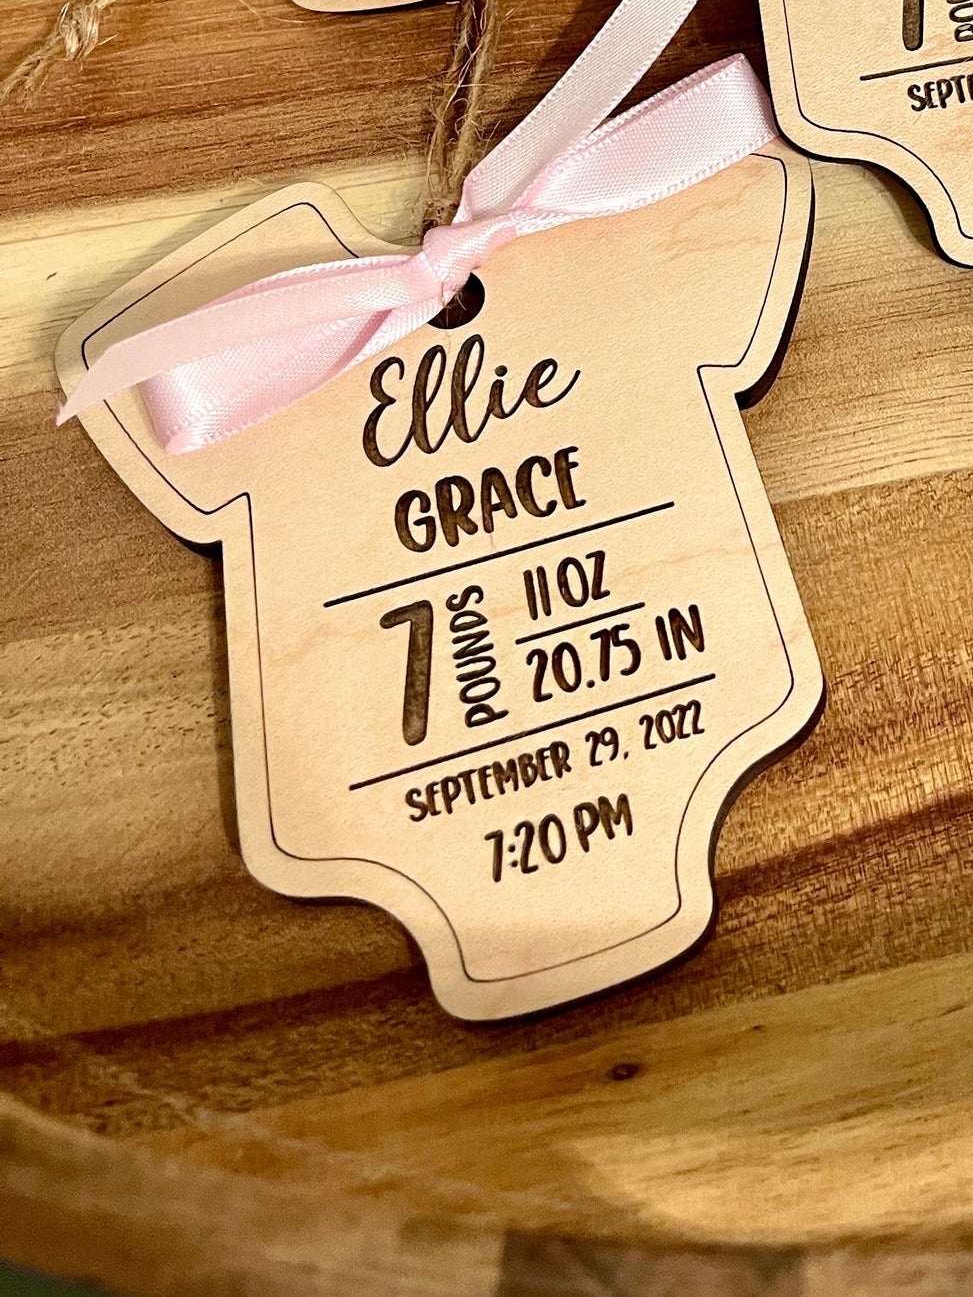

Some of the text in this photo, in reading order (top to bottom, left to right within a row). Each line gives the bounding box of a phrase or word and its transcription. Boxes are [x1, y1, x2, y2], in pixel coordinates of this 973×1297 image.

[362, 333, 581, 467] Ellie
[394, 445, 587, 553] GRACE
[379, 600, 434, 746] 7
[447, 584, 509, 729] POUNDS
[526, 604, 705, 703] 20.75 IN
[405, 741, 571, 823] SEPTEMBER
[638, 700, 705, 751] 2022
[484, 792, 634, 883] 7:20 PM
